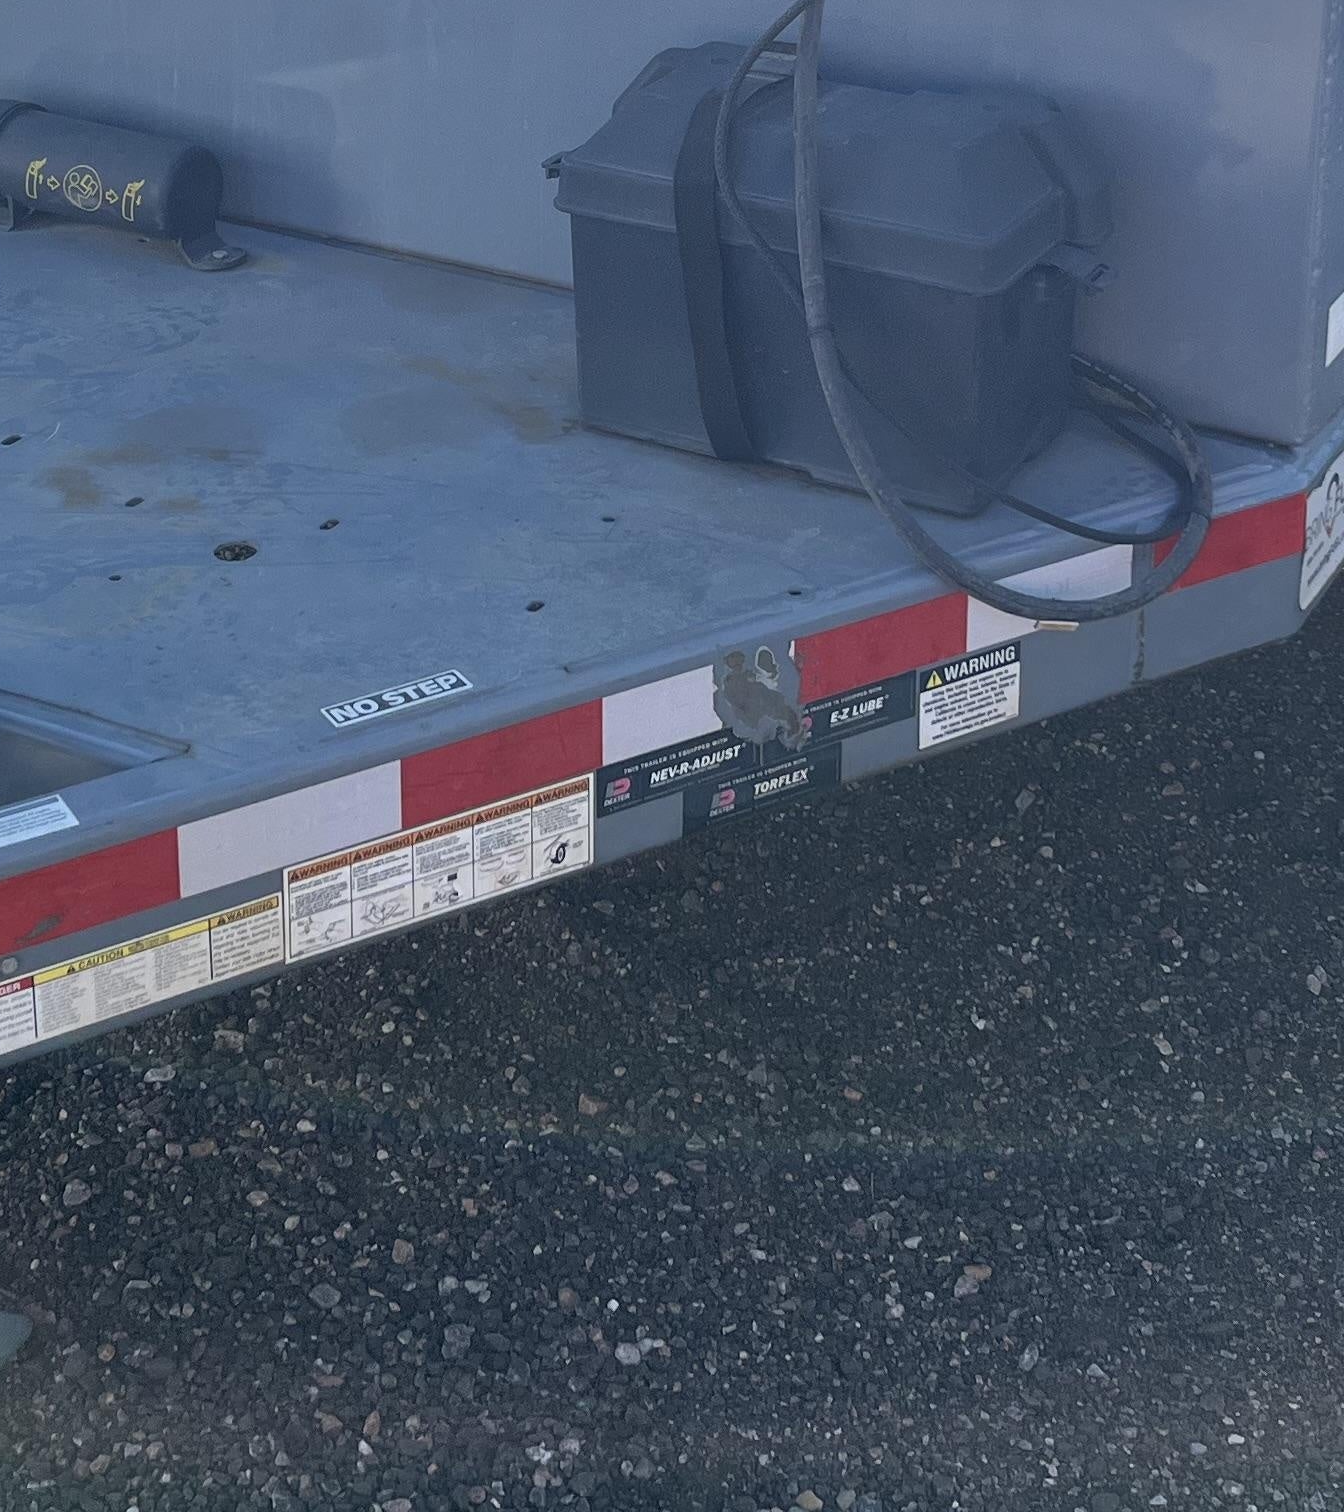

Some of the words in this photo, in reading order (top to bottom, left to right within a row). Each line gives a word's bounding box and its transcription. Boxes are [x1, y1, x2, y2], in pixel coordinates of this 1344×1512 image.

[944, 645, 1016, 681] WARNING
[329, 699, 379, 722] NO
[382, 674, 458, 706] STEP
[829, 706, 851, 724] E-Z
[852, 696, 886, 716] LUBE
[650, 744, 742, 784] NEV-R-ADJUST
[542, 781, 589, 803] WARNING
[753, 767, 810, 796] TORFLEX
[483, 800, 531, 822] WARNING
[422, 819, 472, 842] WARNING
[361, 838, 411, 860] WARNING
[298, 855, 349, 880] WARNING
[78, 949, 124, 970] CAUTION
